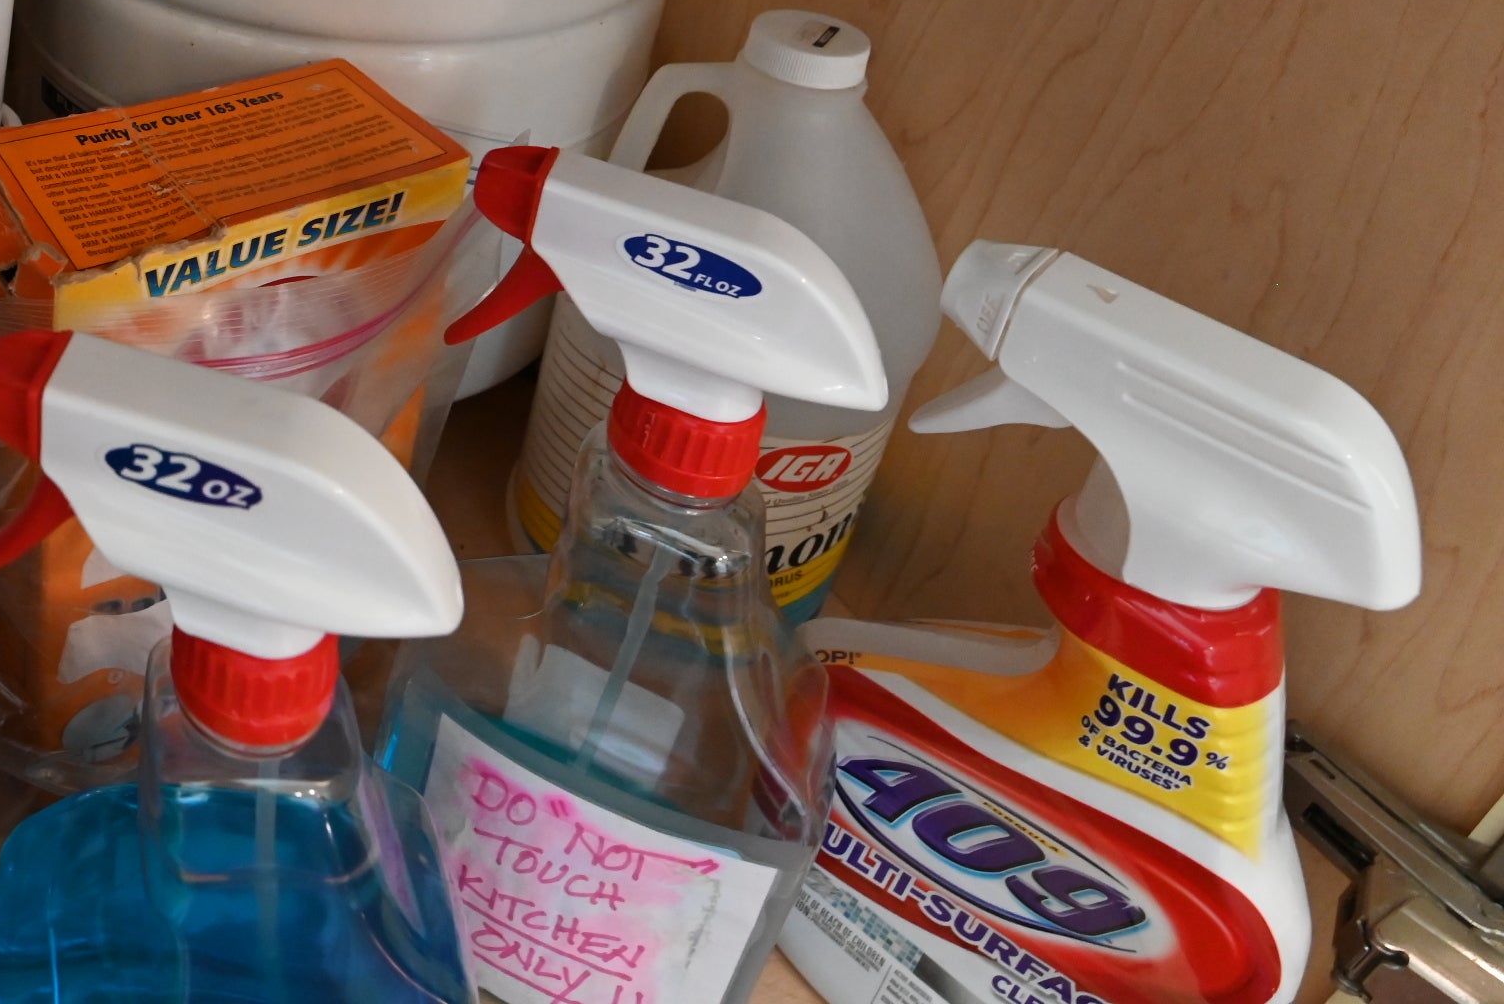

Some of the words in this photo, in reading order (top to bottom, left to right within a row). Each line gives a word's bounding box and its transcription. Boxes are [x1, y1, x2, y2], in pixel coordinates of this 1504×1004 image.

[75, 128, 132, 147] Purity
[131, 118, 160, 134] for
[161, 109, 203, 127] Over
[204, 101, 238, 117] 165
[236, 91, 285, 109] Years
[144, 229, 289, 298] VALUE
[296, 191, 405, 248] SIZE!
[633, 235, 702, 281] 32
[694, 273, 713, 288] FL
[715, 280, 743, 297] OZ
[120, 445, 202, 493] 32
[760, 451, 849, 483] IGA
[1108, 673, 1211, 740] KILLS
[1078, 734, 1091, 748] &
[1080, 714, 1101, 737] OF
[1103, 734, 1193, 786] BACTERIA
[470, 771, 538, 826] DO
[473, 826, 626, 911] TOUCH
[837, 758, 1147, 938] 409
[458, 863, 646, 970] KITCHEN
[819, 906, 844, 930] REACH
[851, 934, 887, 968] CHILDREN
[821, 823, 1113, 1004] ULTI-SURFA
